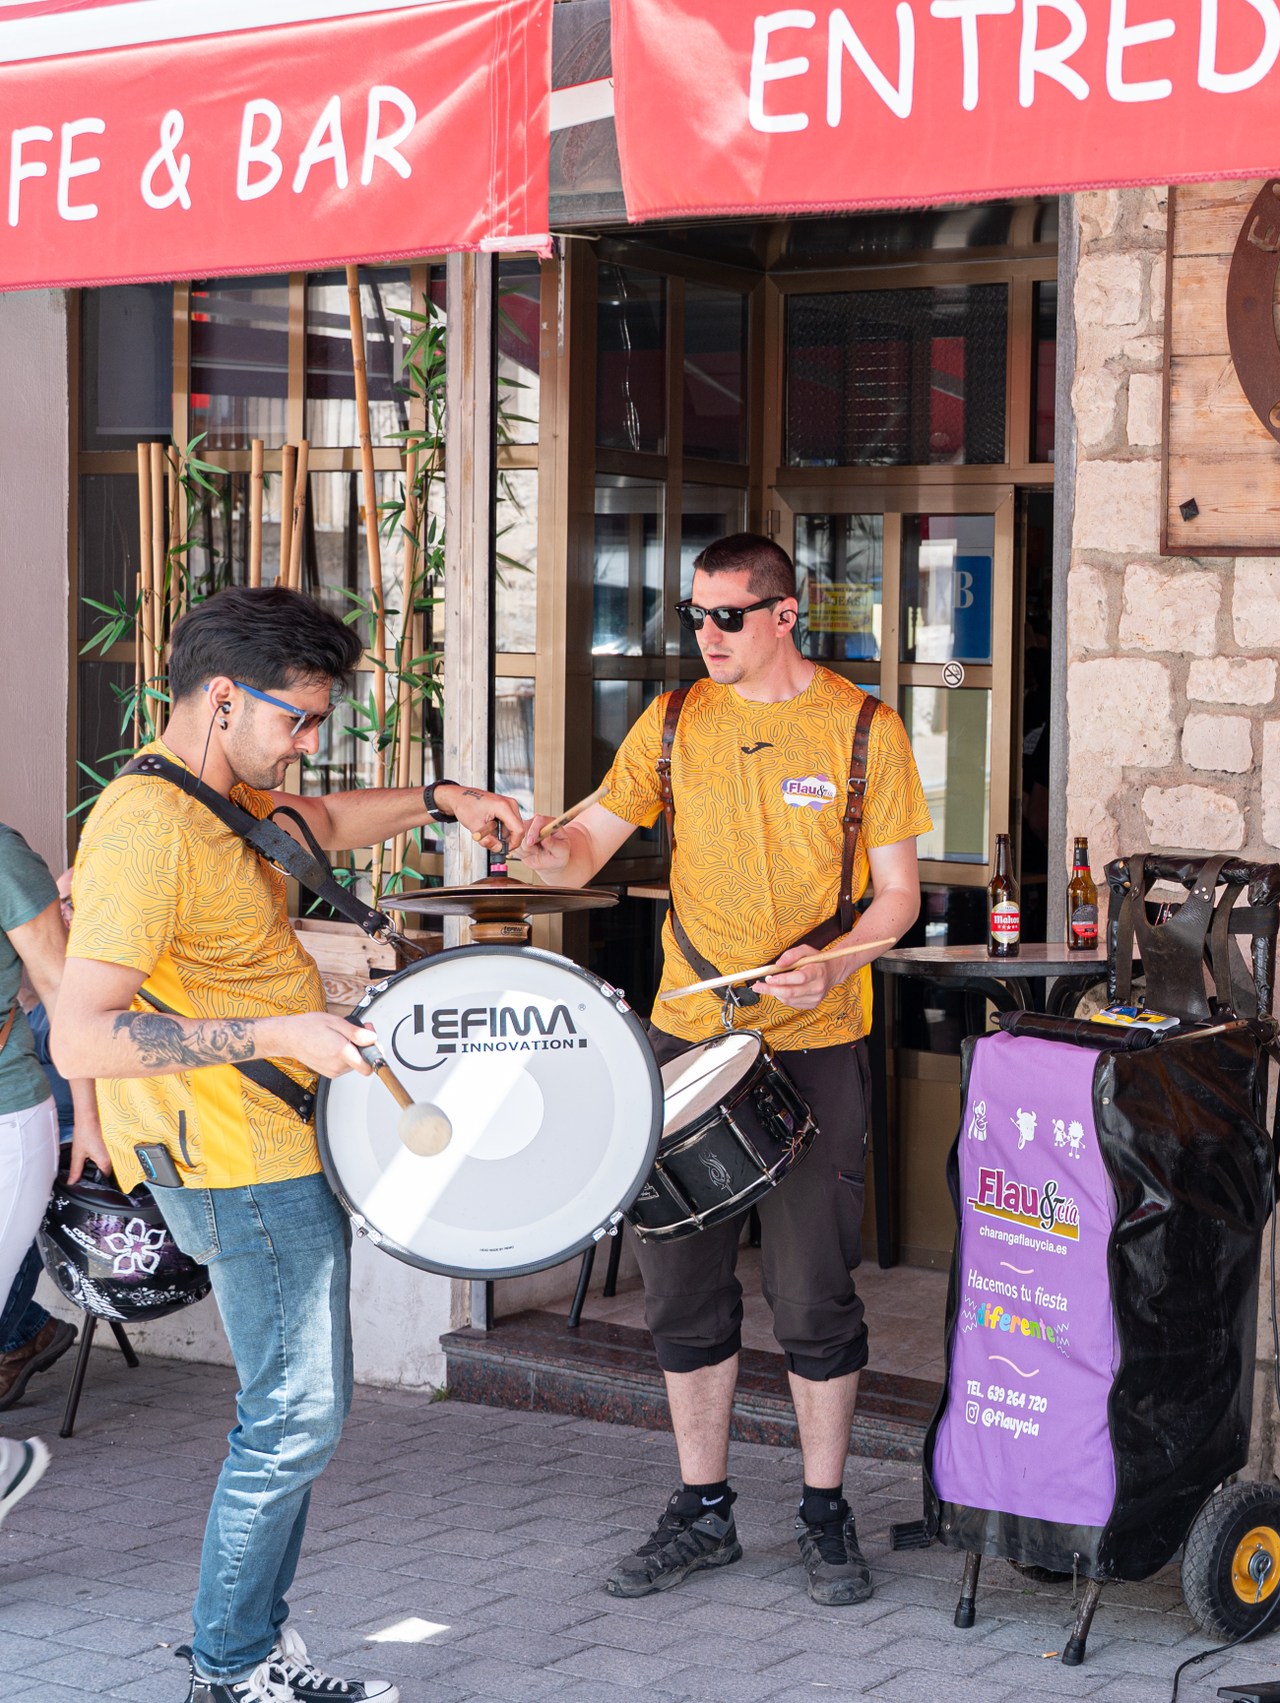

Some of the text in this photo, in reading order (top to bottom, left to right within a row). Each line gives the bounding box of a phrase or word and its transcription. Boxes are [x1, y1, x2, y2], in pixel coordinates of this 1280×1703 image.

[140, 108, 191, 211] &
[235, 85, 417, 201] BAR
[461, 1038, 574, 1053] INNOVATION
[979, 1225, 1068, 1255] charangaflauycia.es
[967, 1268, 1068, 1312] Hacemos tu fiesta
[977, 1302, 1056, 1343] diferente
[966, 1380, 1048, 1413] TEL. 639 264 720
